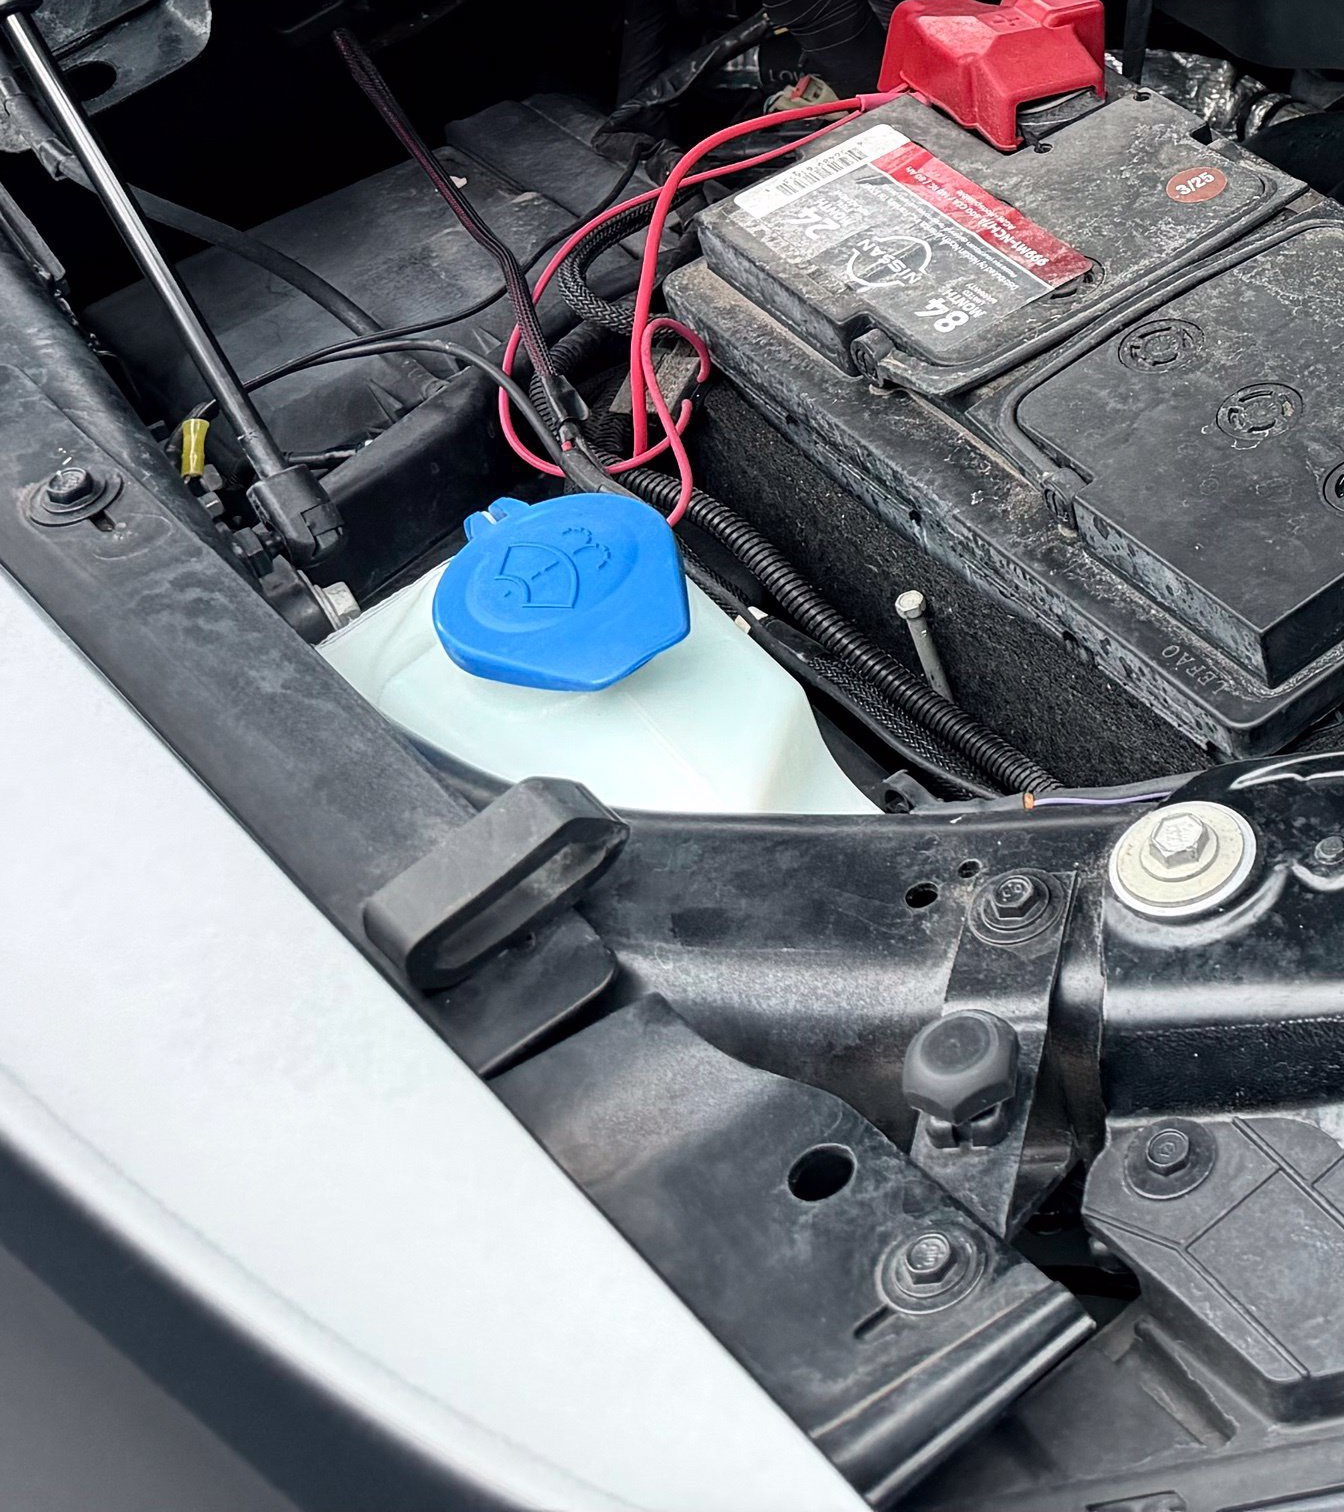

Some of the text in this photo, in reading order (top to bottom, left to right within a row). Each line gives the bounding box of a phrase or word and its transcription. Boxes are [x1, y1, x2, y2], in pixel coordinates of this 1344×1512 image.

[1175, 171, 1214, 194] 3/25
[787, 207, 840, 239] 24
[812, 196, 856, 226] MONTH
[855, 237, 922, 284] NISSAN
[914, 298, 969, 333] 84
[940, 287, 987, 318] MONTH
